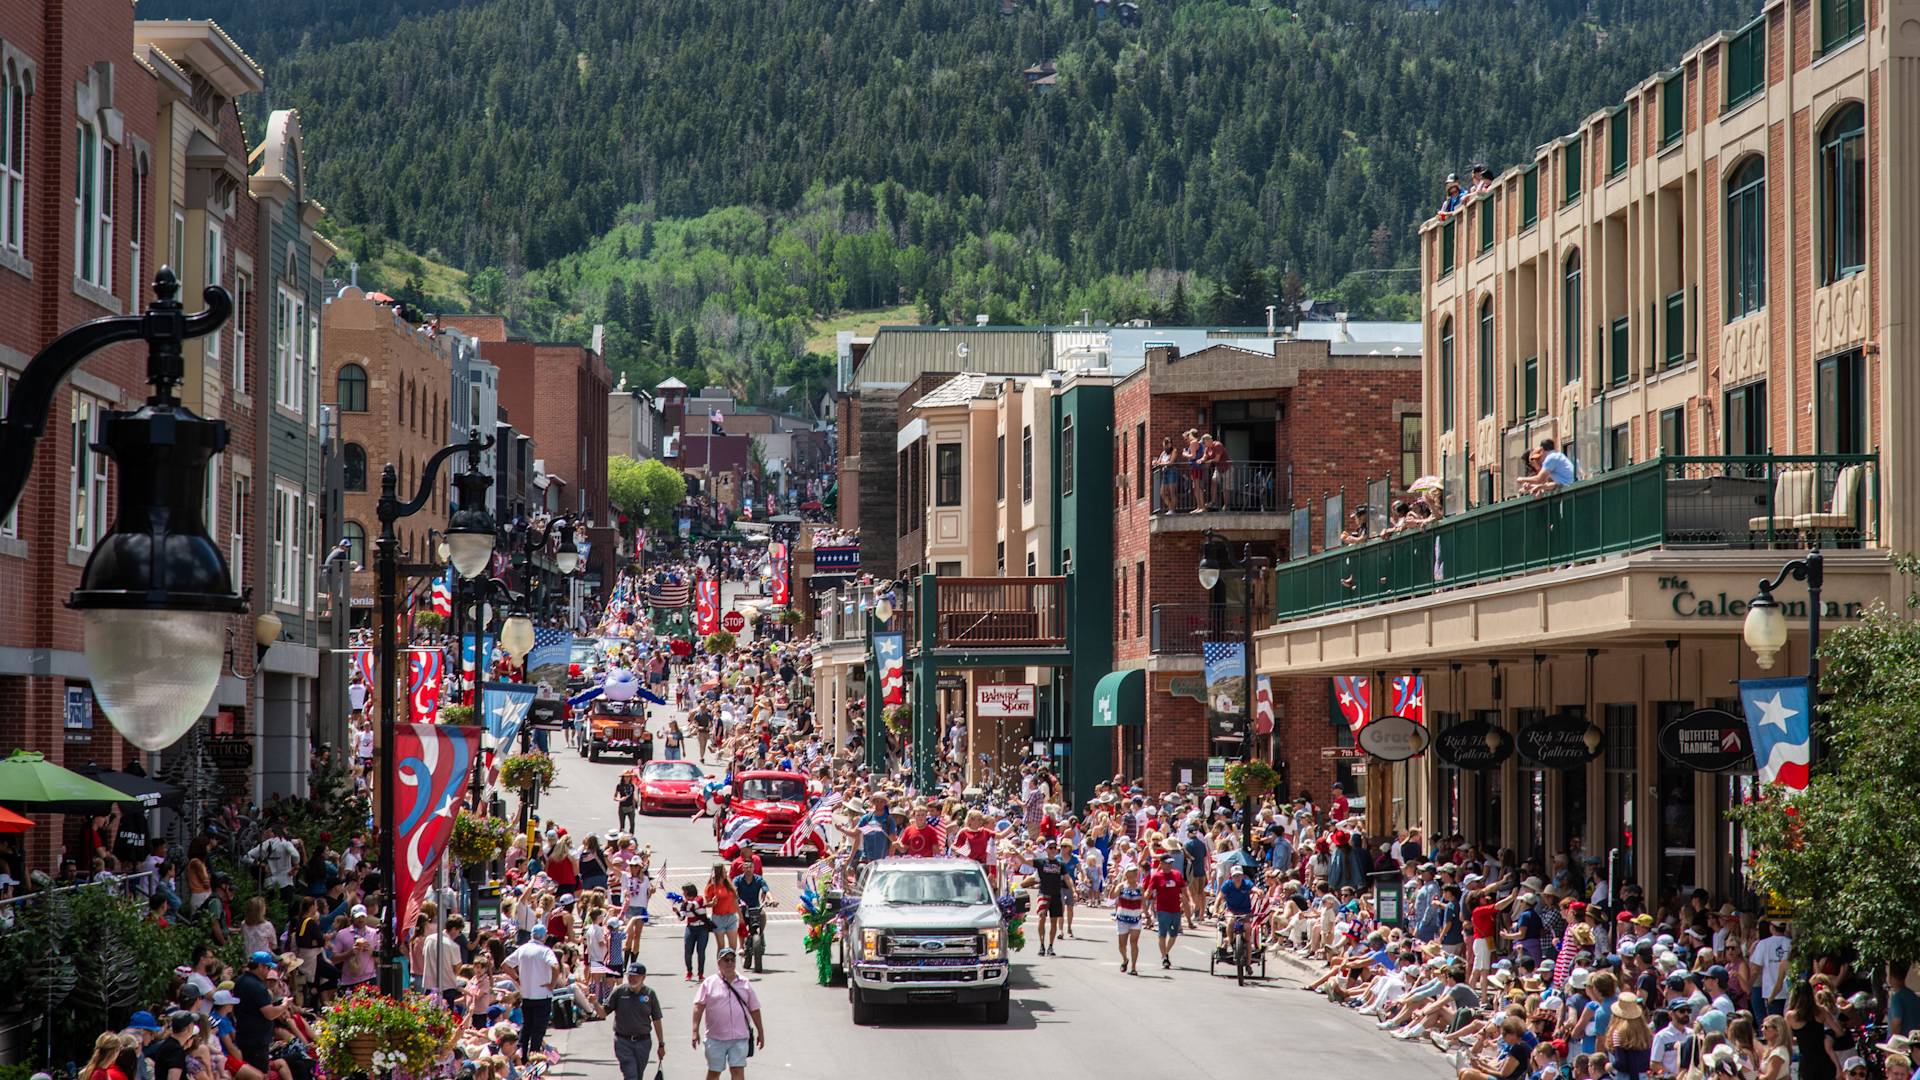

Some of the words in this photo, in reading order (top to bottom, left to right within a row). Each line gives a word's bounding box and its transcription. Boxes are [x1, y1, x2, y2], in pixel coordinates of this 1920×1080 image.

[1658, 576, 1688, 590] The
[1671, 591, 1863, 617] Calenan
[724, 617, 744, 627] STOP
[1371, 730, 1410, 743] Grac
[1527, 730, 1553, 746] Rich
[1679, 728, 1719, 741] OUTFITTER
[1443, 735, 1467, 750] Rich
[1679, 742, 1713, 754] TRADING
[1341, 749, 1353, 757] 7th
